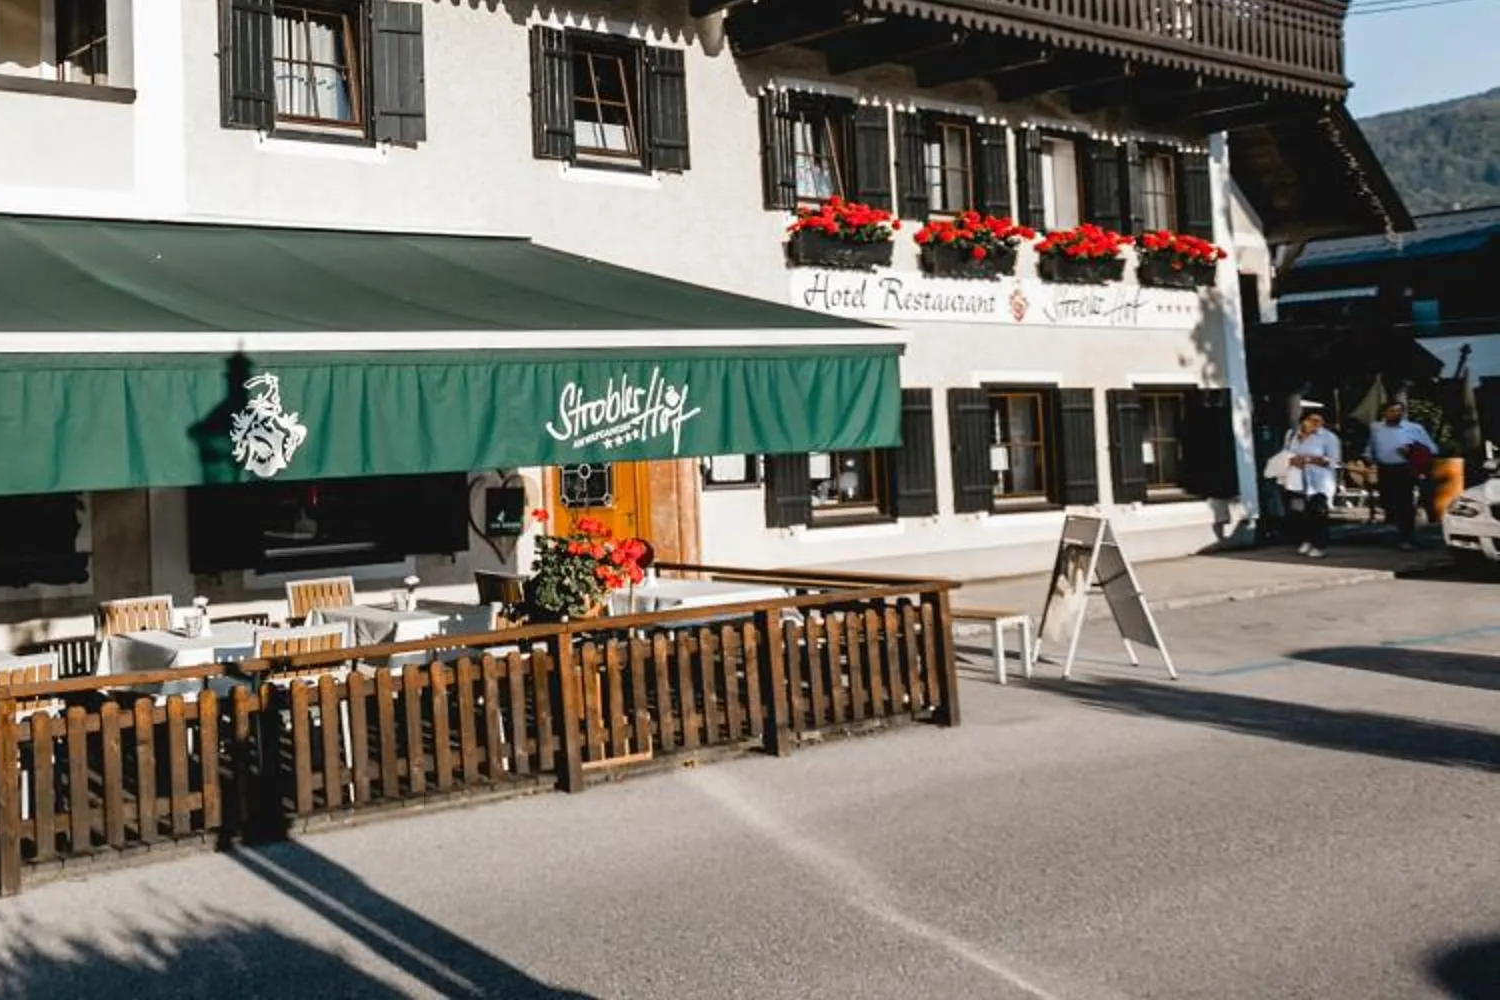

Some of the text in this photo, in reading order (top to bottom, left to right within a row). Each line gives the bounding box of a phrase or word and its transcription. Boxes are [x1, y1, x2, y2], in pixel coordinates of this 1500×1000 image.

[804, 274, 996, 314] Hotel Restaurant
[546, 366, 701, 455] Strobler Hof
